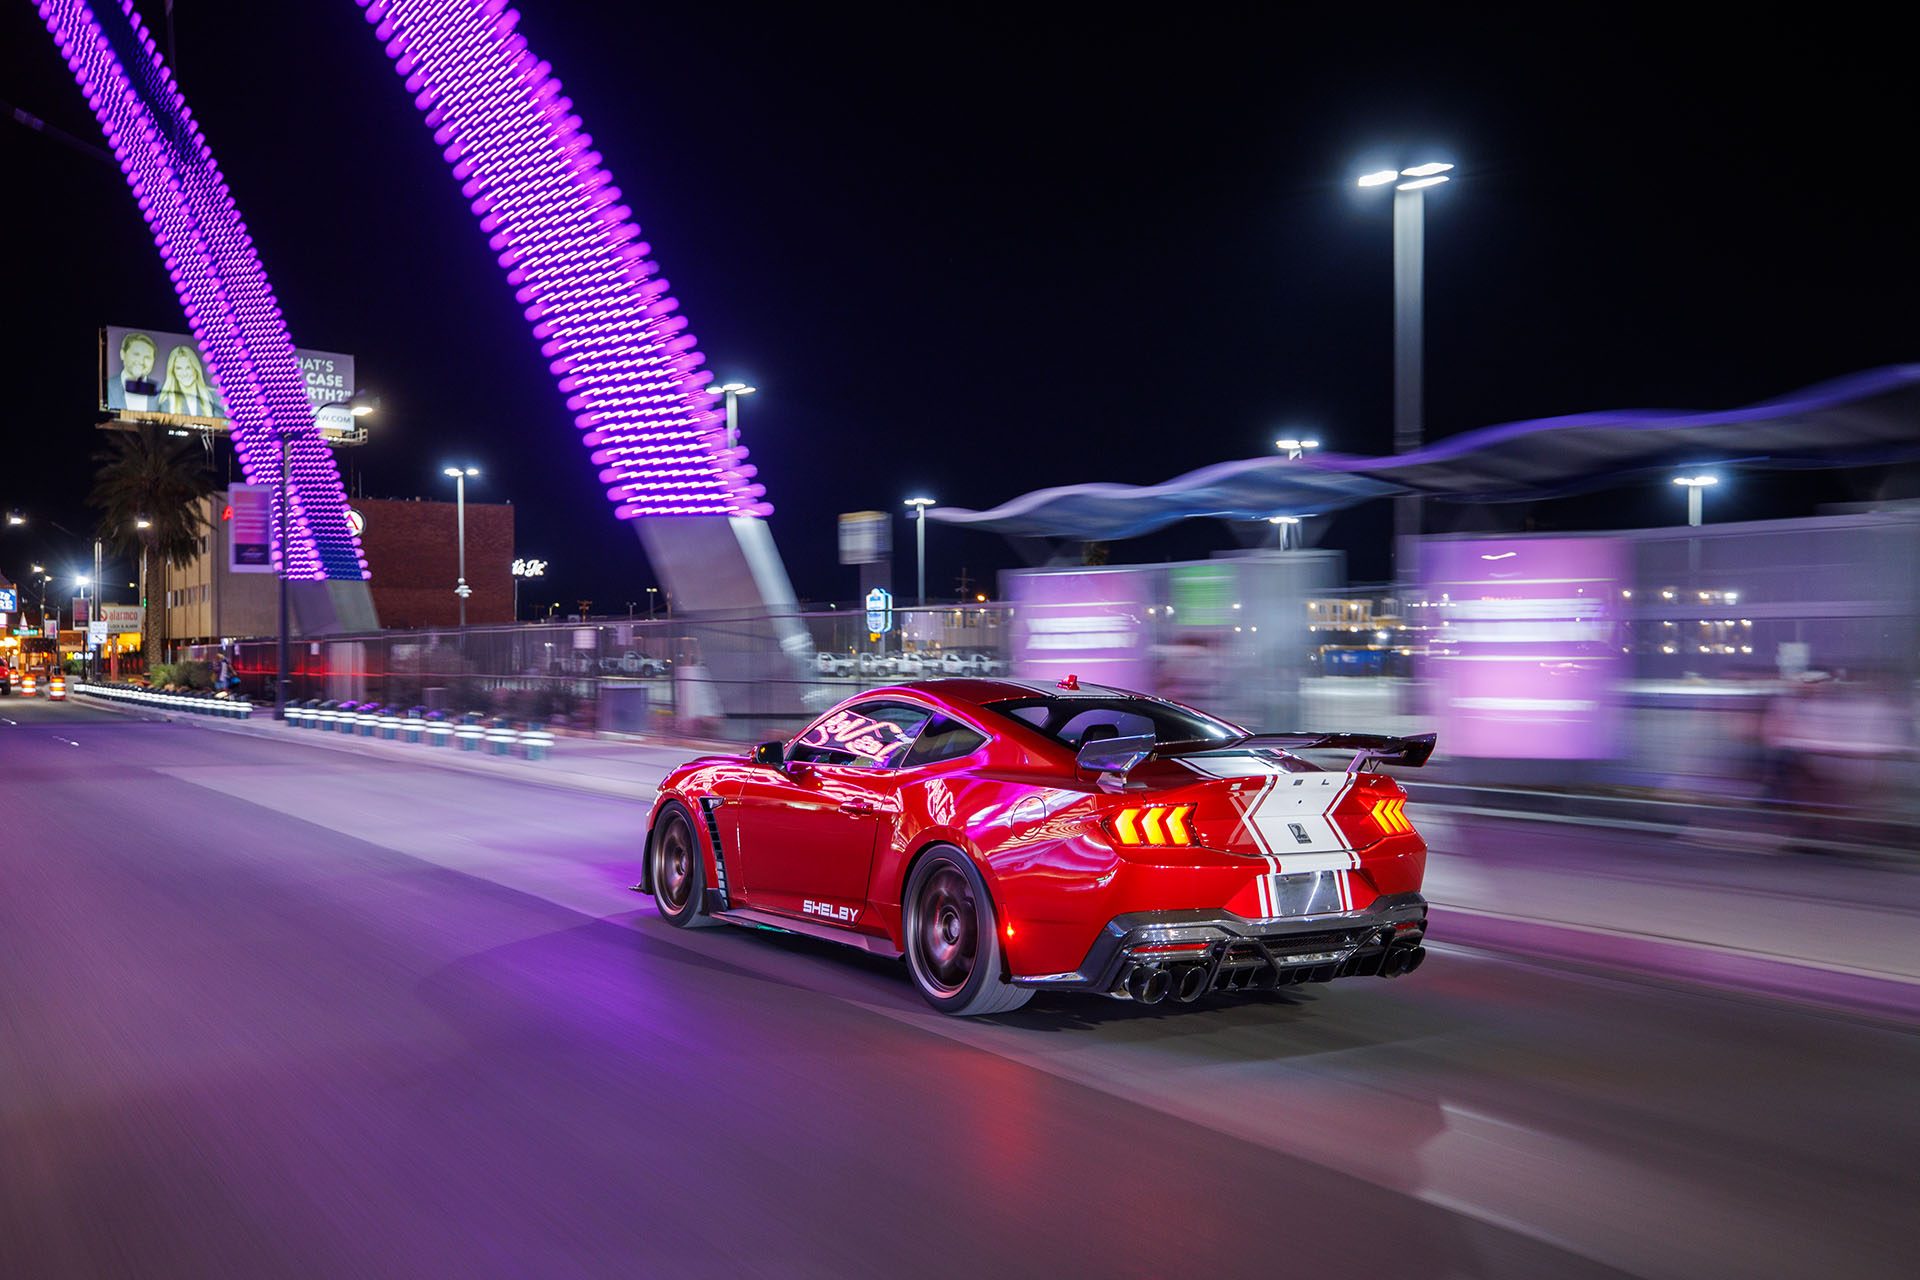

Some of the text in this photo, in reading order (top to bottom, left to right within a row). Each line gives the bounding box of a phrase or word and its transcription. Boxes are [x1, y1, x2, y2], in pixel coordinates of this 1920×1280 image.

[296, 357, 334, 373] HAT'S
[306, 372, 343, 387] CASE
[803, 899, 859, 922] SHELBY
